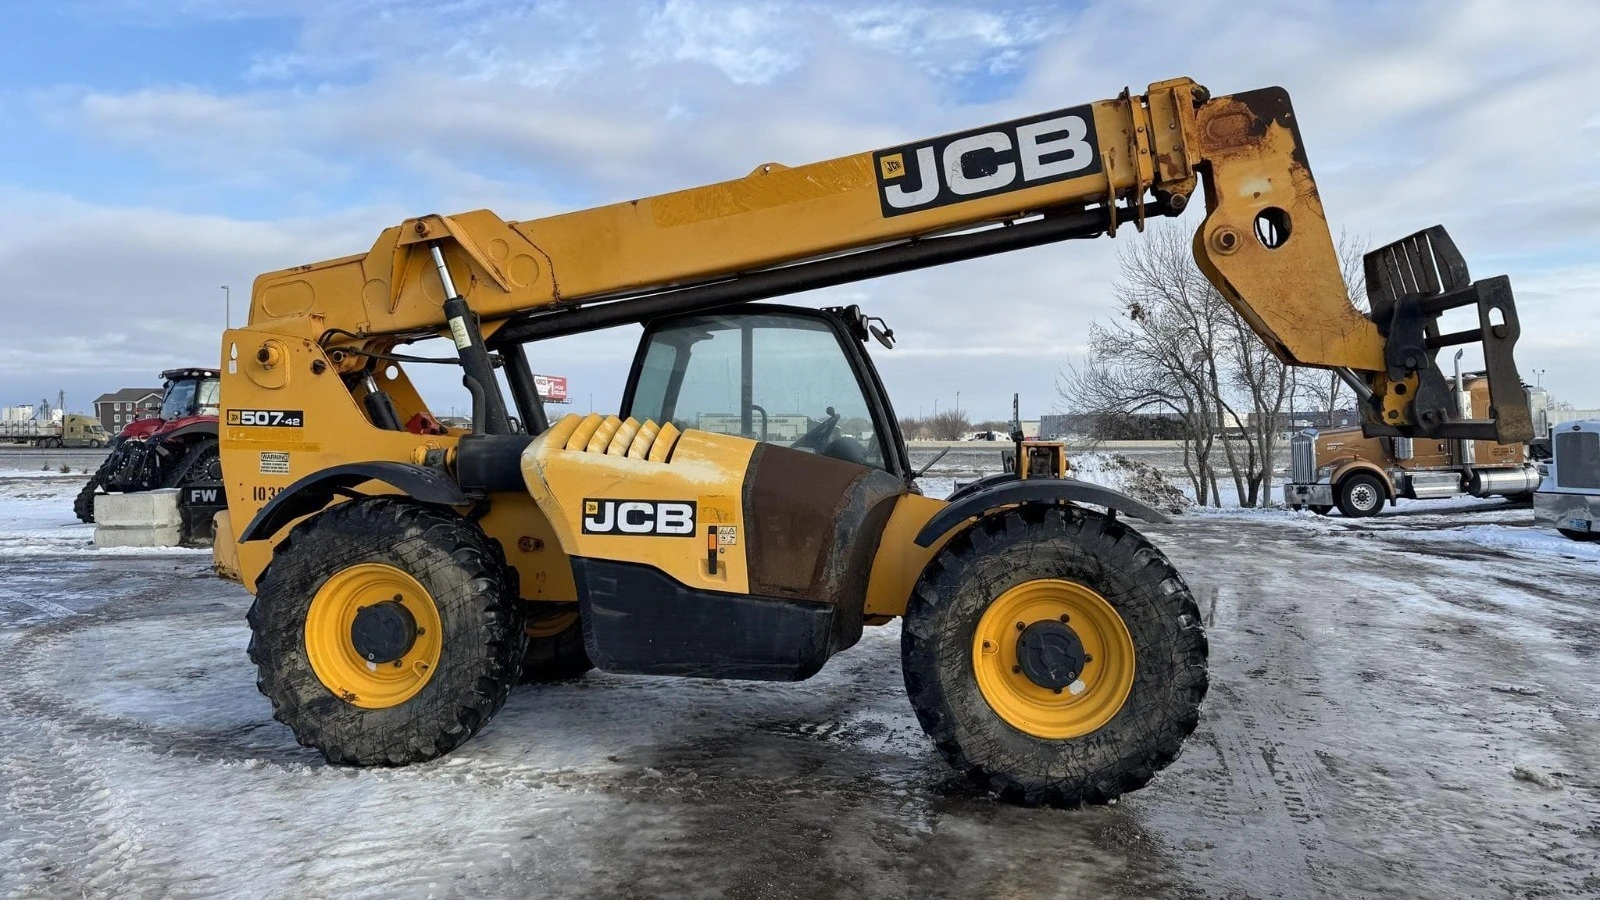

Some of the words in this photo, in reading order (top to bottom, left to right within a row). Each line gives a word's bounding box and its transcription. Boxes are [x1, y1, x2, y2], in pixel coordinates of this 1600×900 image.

[884, 115, 1094, 209] JCB
[886, 159, 902, 173] JCB
[241, 411, 301, 426] 507-42
[191, 489, 218, 503] FW
[585, 501, 694, 534] JCB
